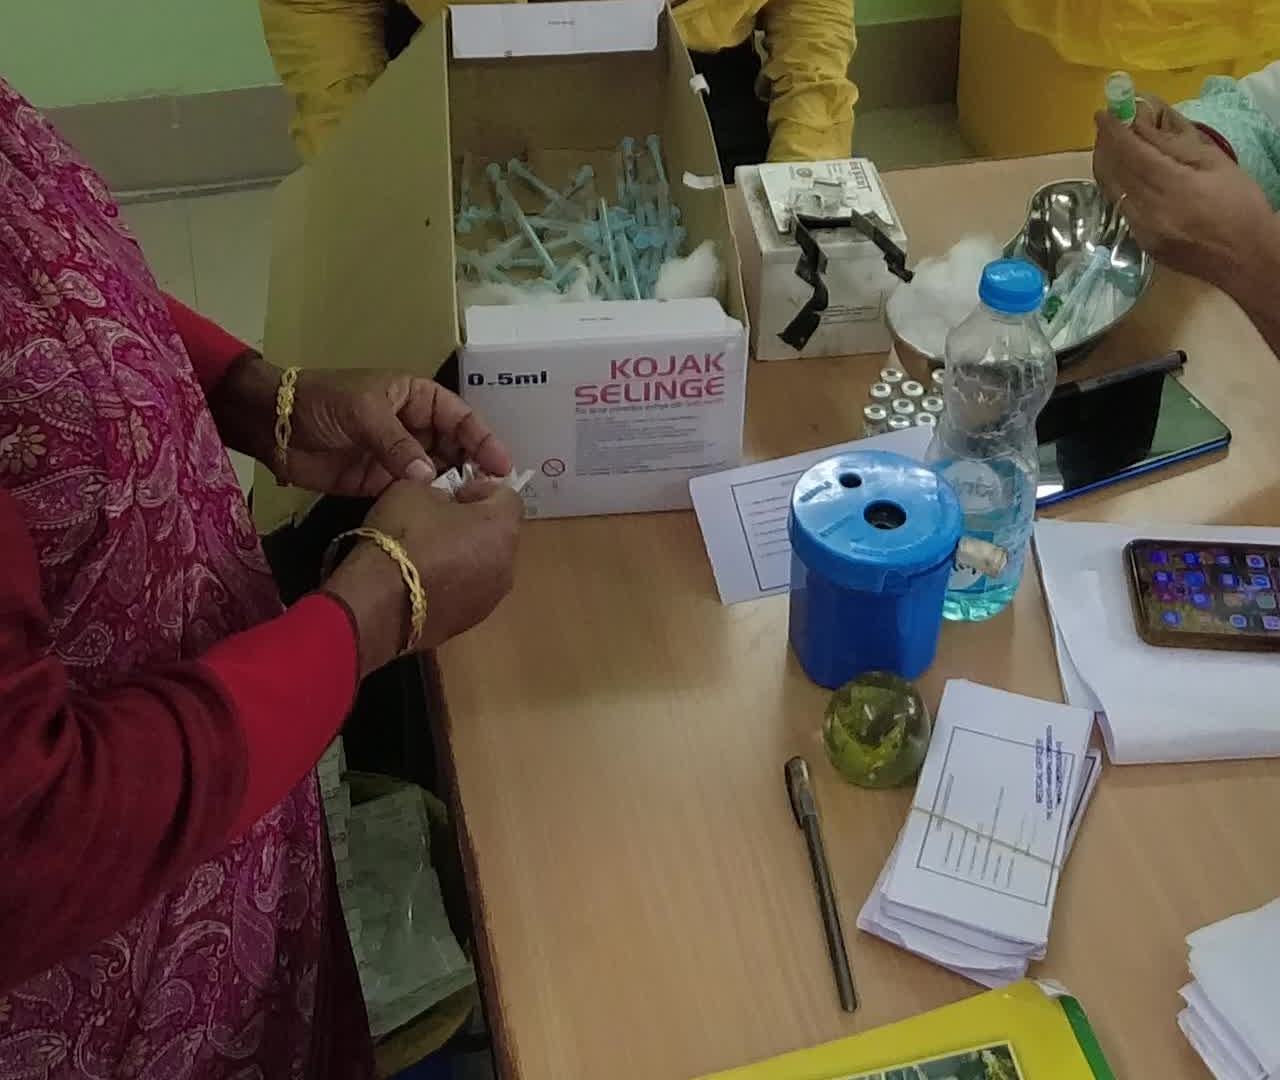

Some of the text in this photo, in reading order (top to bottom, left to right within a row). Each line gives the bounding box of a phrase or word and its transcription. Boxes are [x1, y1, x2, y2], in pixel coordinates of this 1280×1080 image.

[467, 370, 547, 386] 0.5ml
[610, 352, 725, 380] KOJAK
[574, 376, 725, 406] SELINGE
